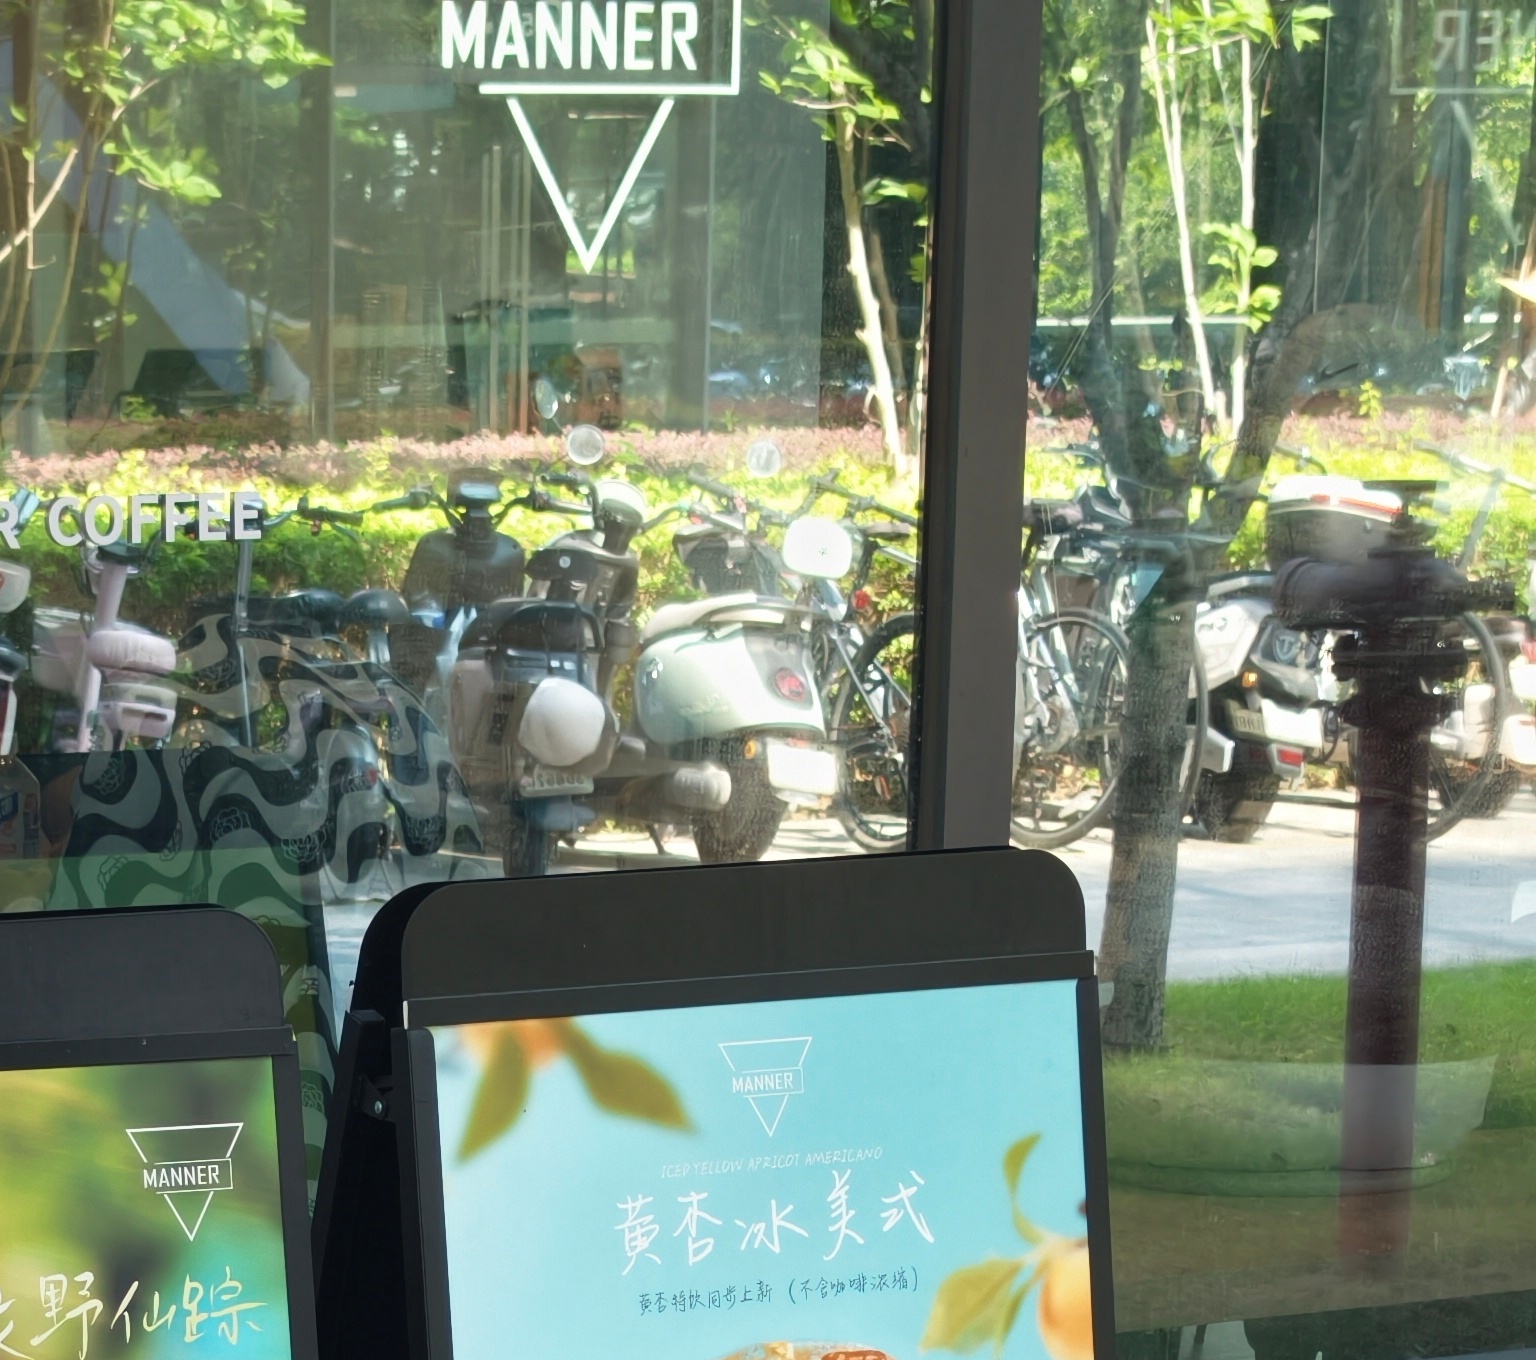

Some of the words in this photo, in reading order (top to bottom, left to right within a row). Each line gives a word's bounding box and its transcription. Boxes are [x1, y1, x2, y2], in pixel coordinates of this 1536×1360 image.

[441, 0, 698, 70] MANNER
[47, 492, 263, 547] COFFEE
[732, 1072, 793, 1094] MANNER
[143, 1164, 221, 1189] MANNER
[747, 1153, 801, 1171] APRICOT
[805, 1146, 884, 1166] AMERICANO
[614, 1168, 935, 1276] 黄杏冰美式
